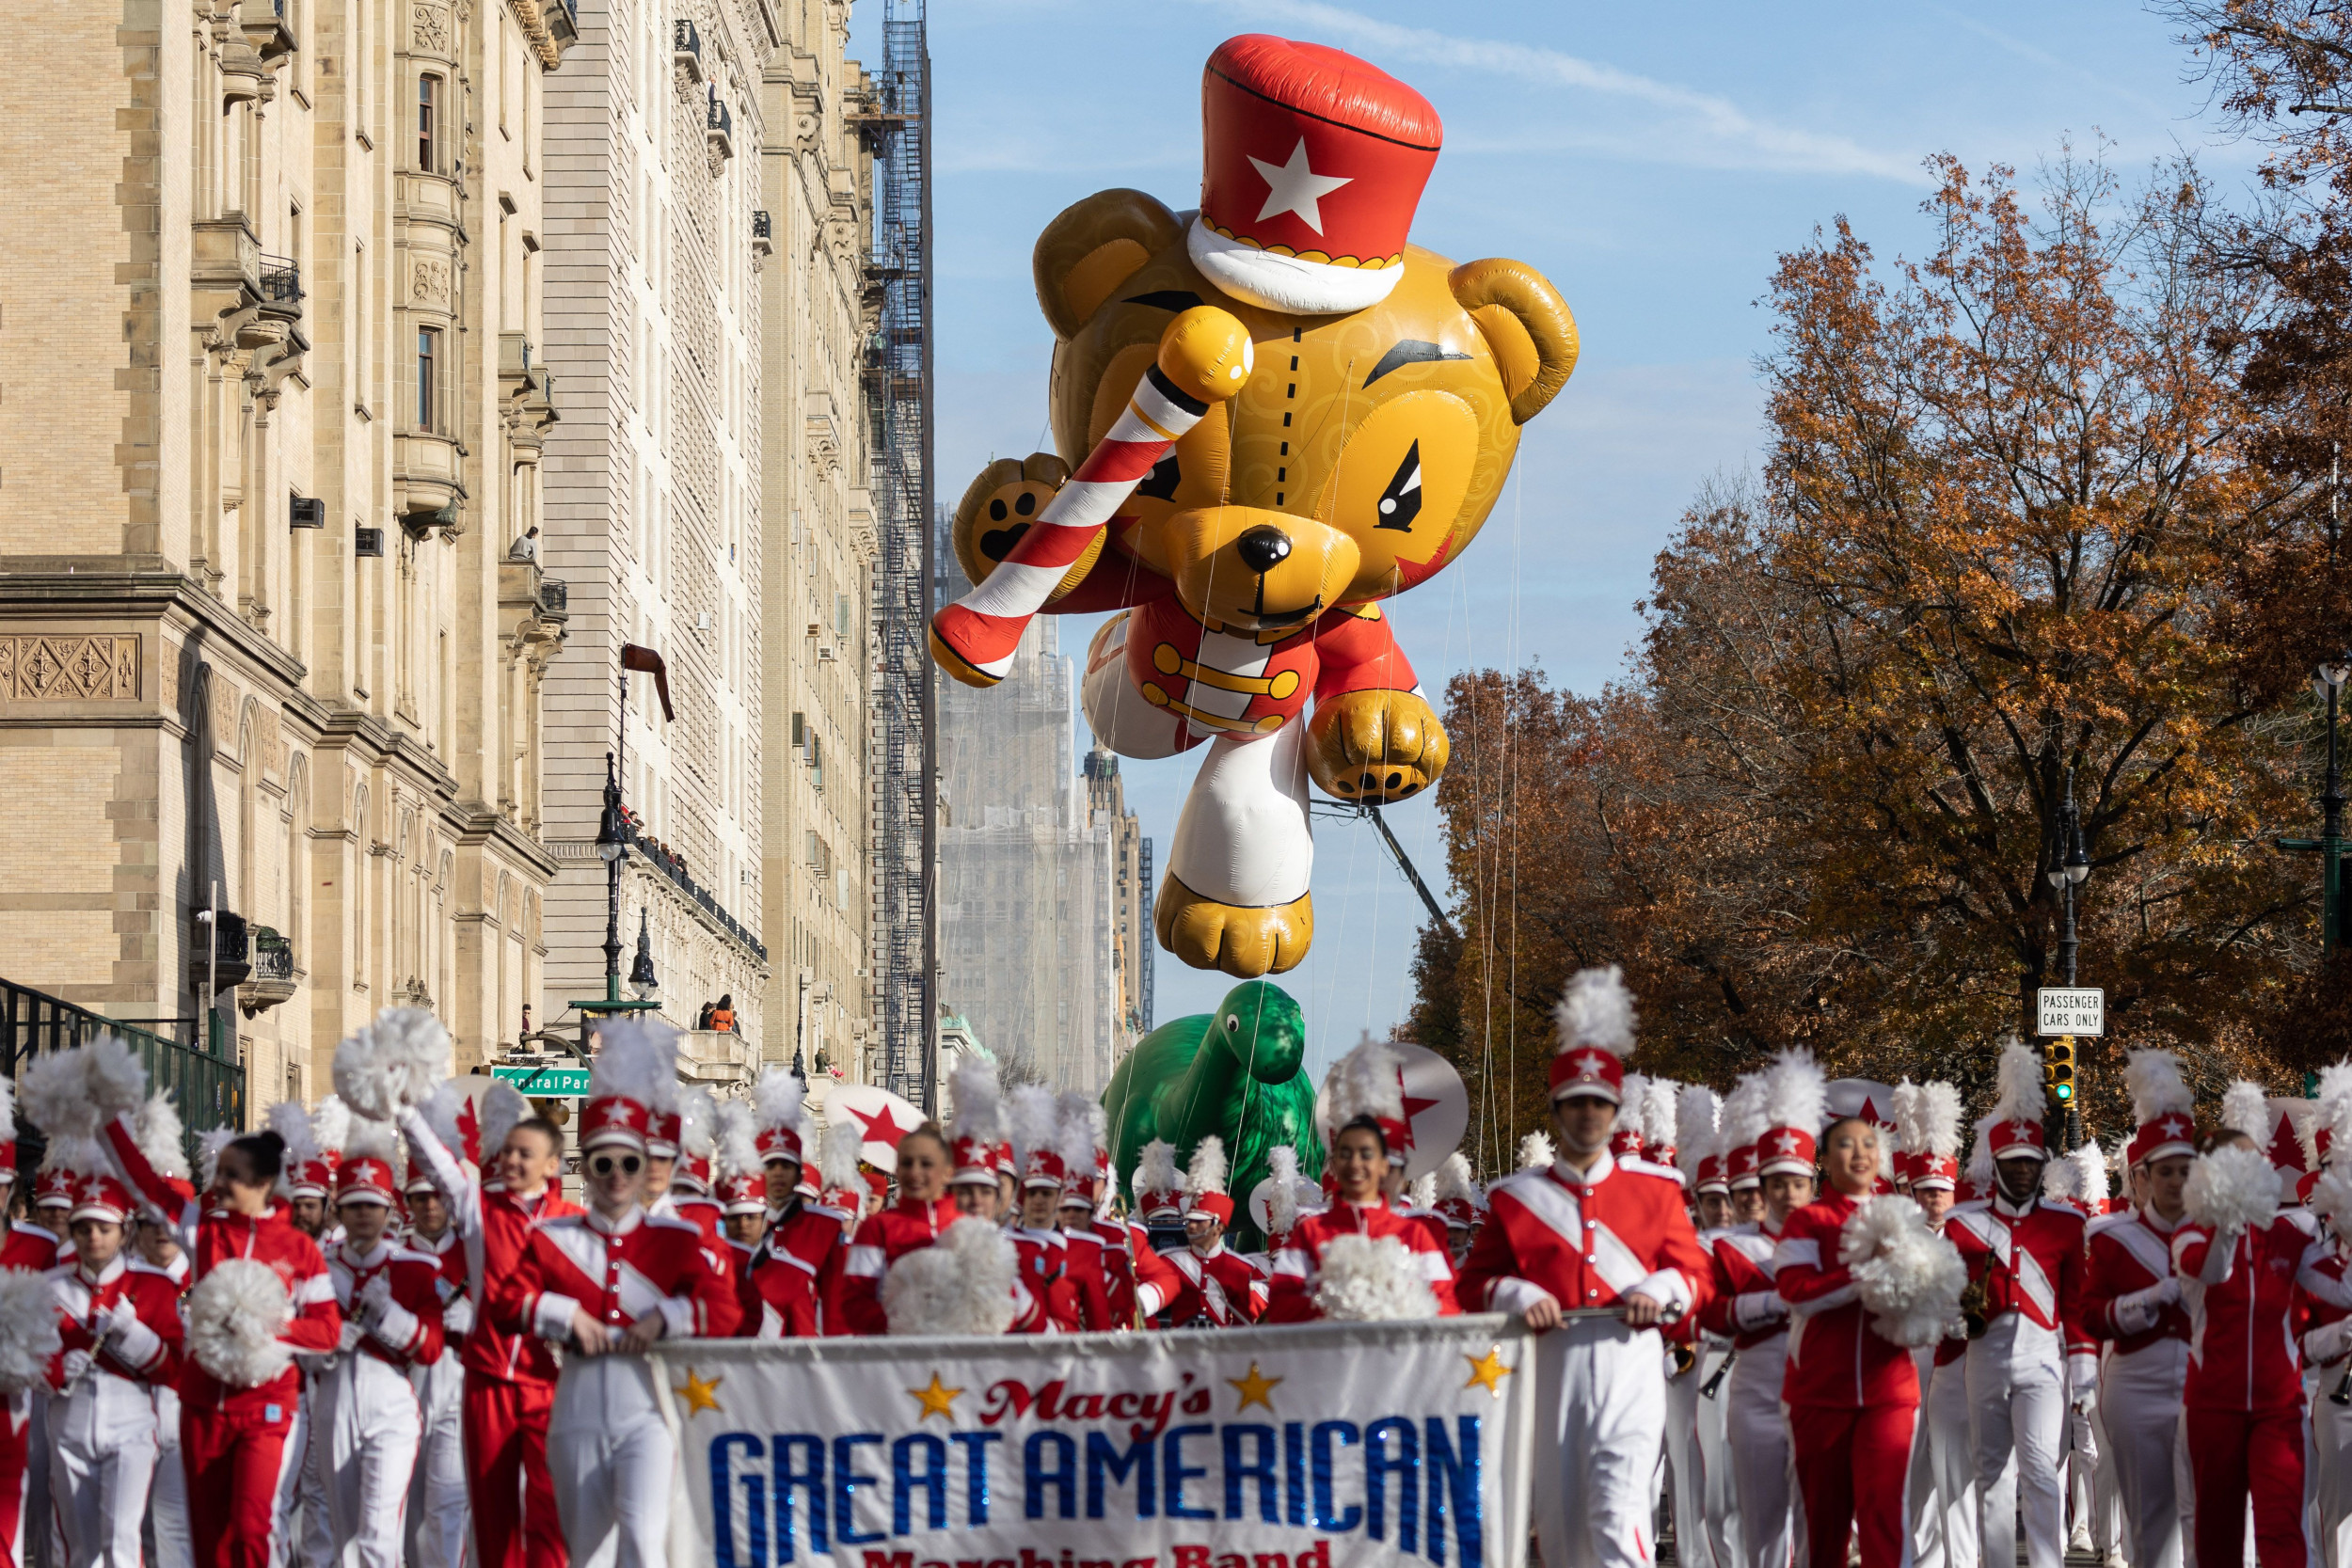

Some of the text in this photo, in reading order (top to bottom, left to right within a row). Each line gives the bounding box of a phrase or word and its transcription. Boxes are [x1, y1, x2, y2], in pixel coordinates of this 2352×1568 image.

[2043, 995, 2099, 1008] PASSENGER
[2043, 1013, 2099, 1027] CARS ONLY
[563, 1076, 590, 1089] Par
[979, 1371, 1211, 1444] Macy's
[709, 1415, 1483, 1568] GREAT AMERICAN
